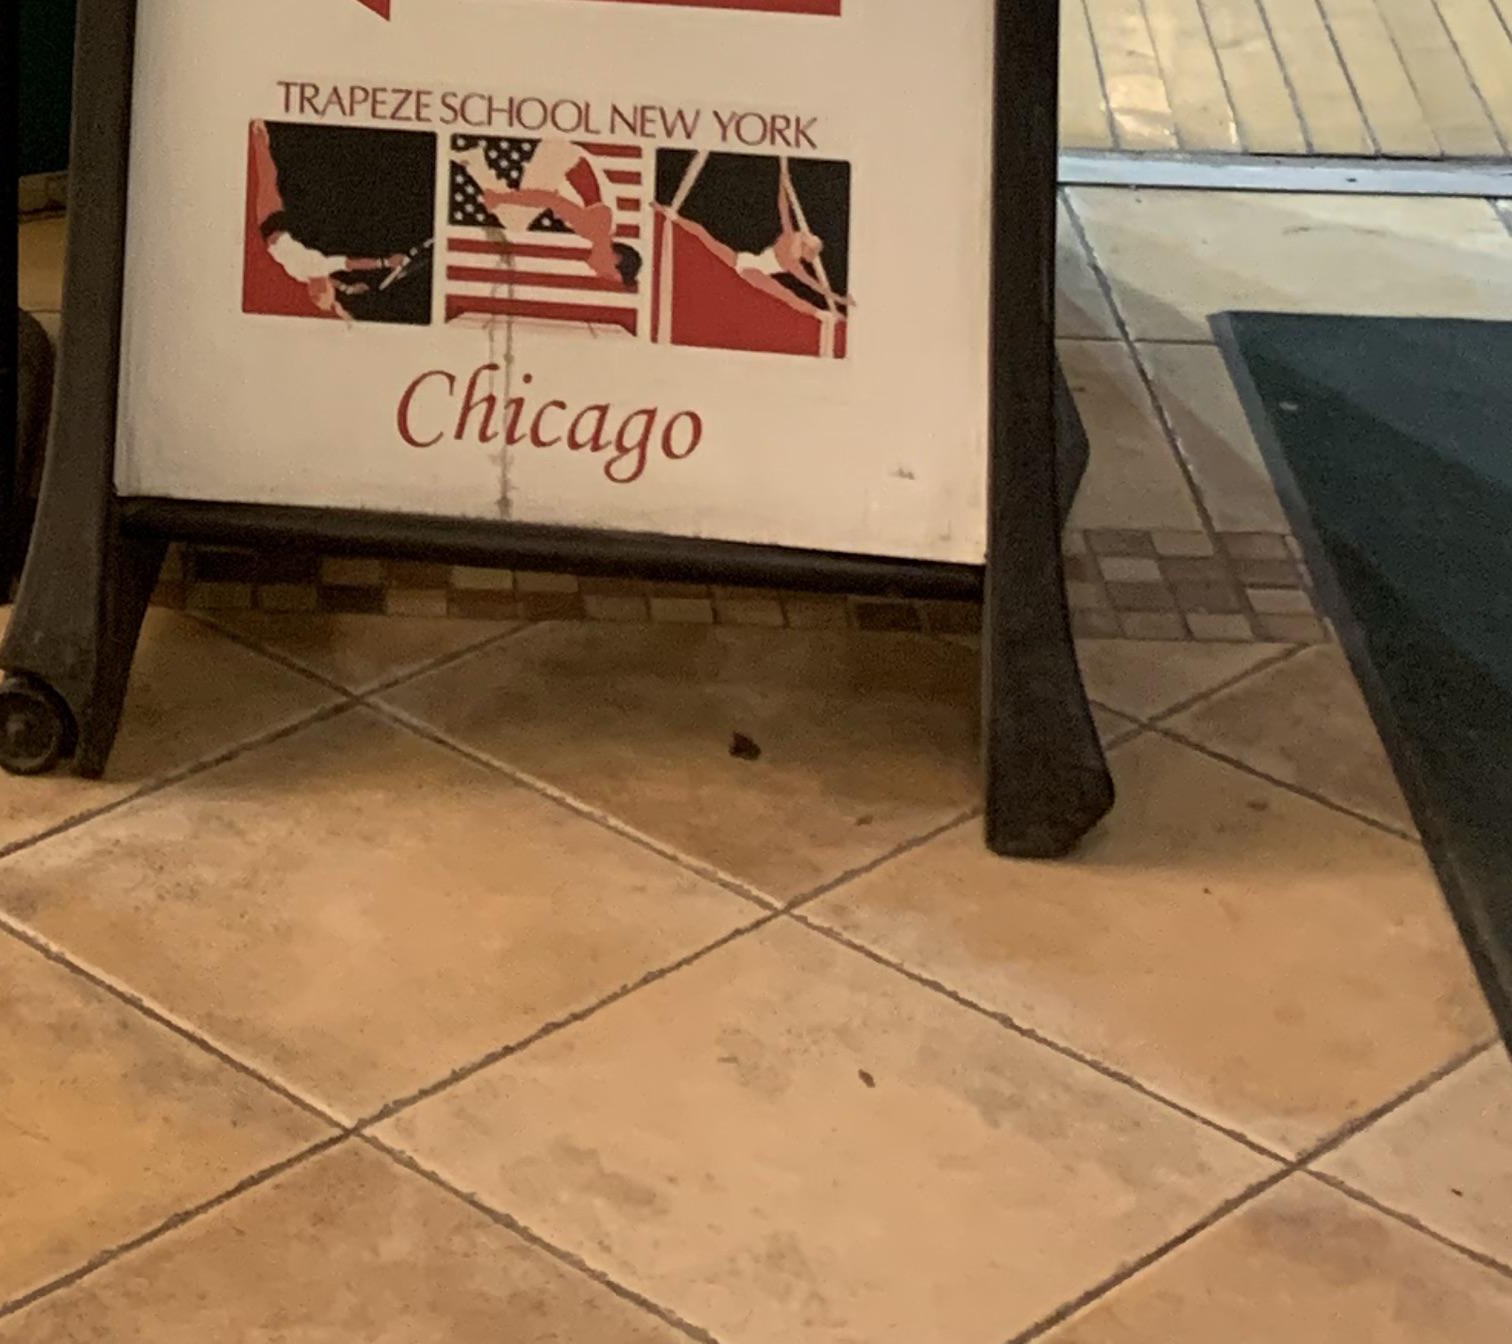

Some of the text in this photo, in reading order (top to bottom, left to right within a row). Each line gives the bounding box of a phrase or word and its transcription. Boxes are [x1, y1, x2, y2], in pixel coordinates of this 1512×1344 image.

[276, 79, 820, 151] TRAPEZE SCHOOL NEW YORK
[396, 362, 705, 484] Chicago
